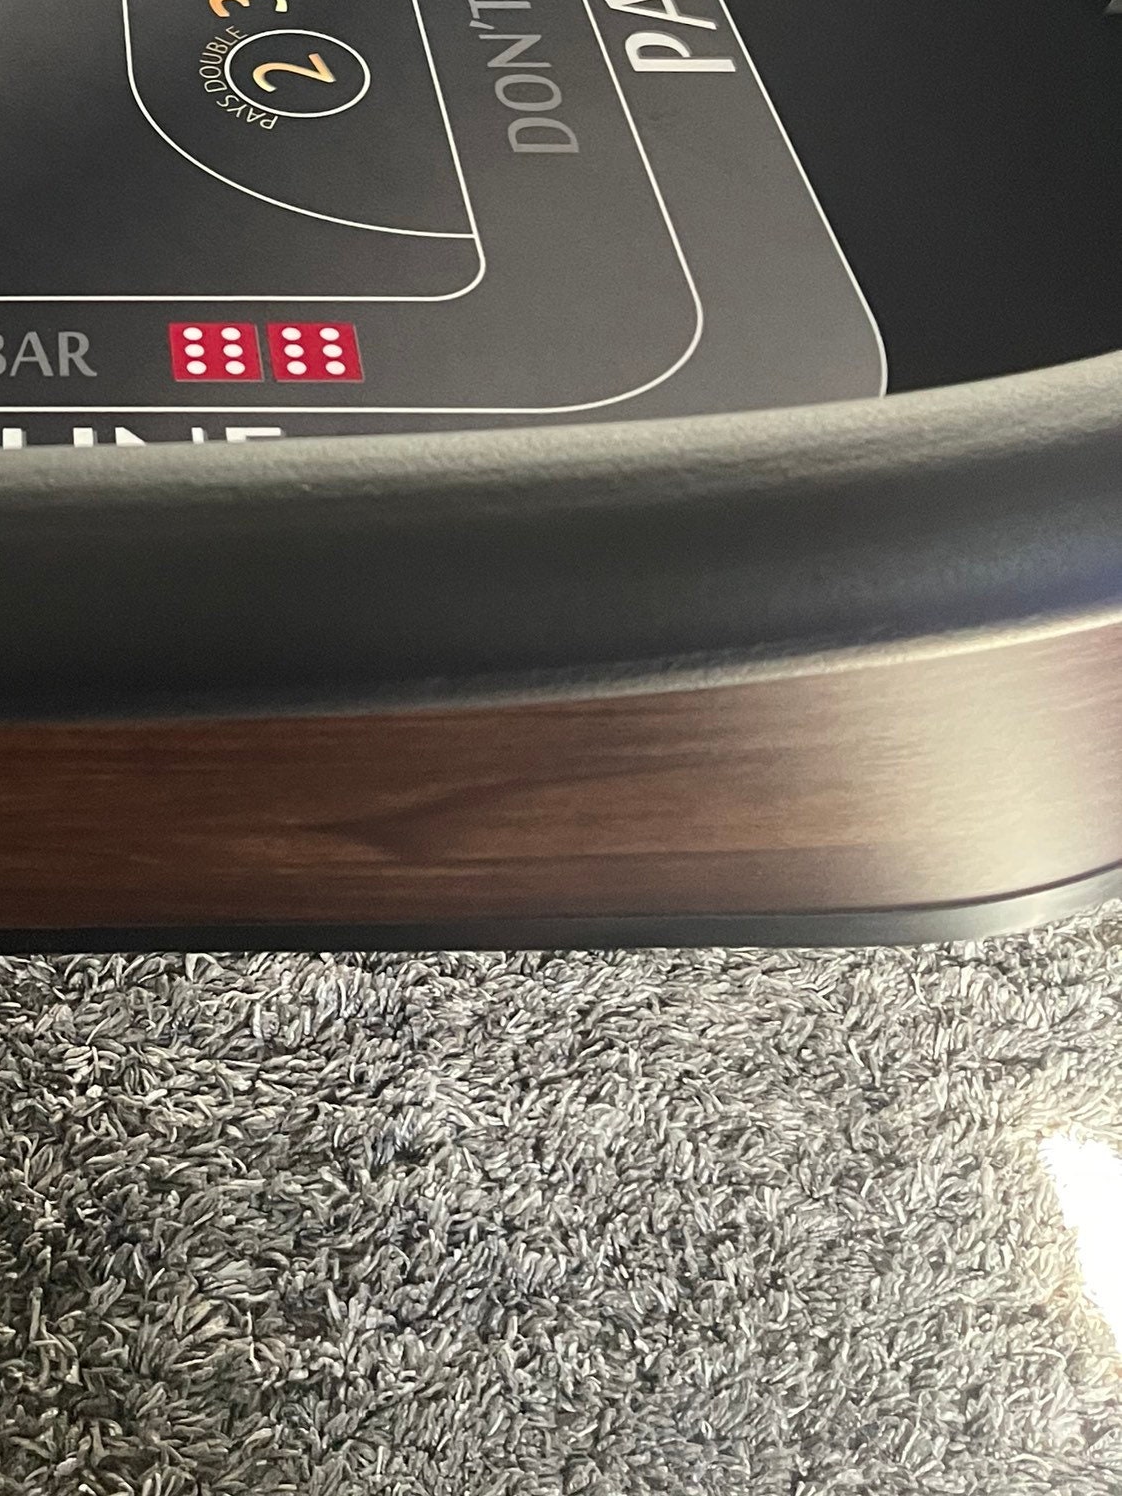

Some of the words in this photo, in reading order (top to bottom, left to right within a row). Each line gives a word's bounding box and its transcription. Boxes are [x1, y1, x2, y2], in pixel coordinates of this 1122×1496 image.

[199, 25, 249, 93] DOUBLE
[252, 53, 338, 93] 2
[216, 94, 279, 130] PAYS
